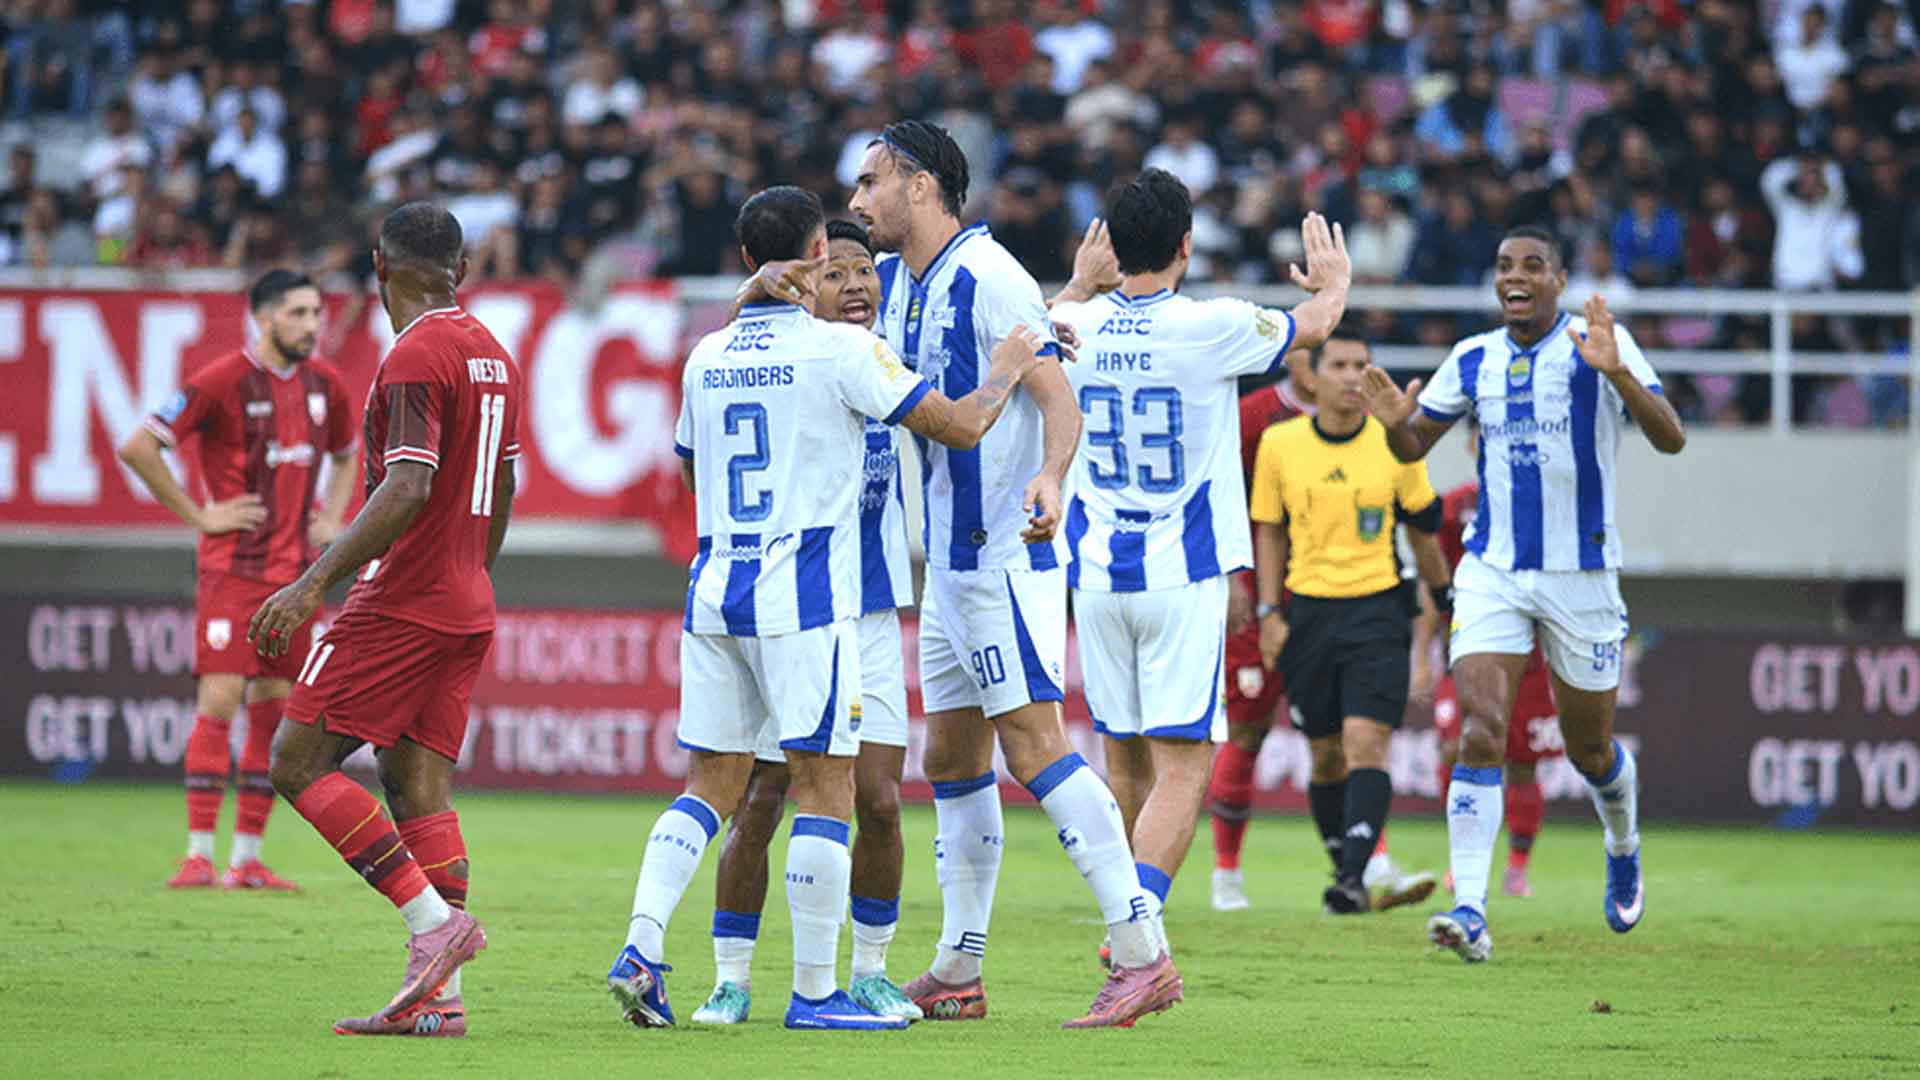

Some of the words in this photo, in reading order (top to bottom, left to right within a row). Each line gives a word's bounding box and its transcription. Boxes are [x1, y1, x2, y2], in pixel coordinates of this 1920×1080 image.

[724, 333, 775, 353] ABC
[1095, 351, 1152, 371] HAYE
[1097, 318, 1153, 335] ABC
[471, 392, 505, 518] 11
[724, 402, 774, 512] 2
[1079, 385, 1186, 494] 33
[28, 606, 116, 672] GET
[297, 641, 335, 687] 11
[971, 645, 1006, 689] 90
[1751, 644, 1844, 714] GET
[26, 694, 116, 763] GET
[486, 704, 652, 777] TICKET
[1749, 737, 1844, 808] GET
